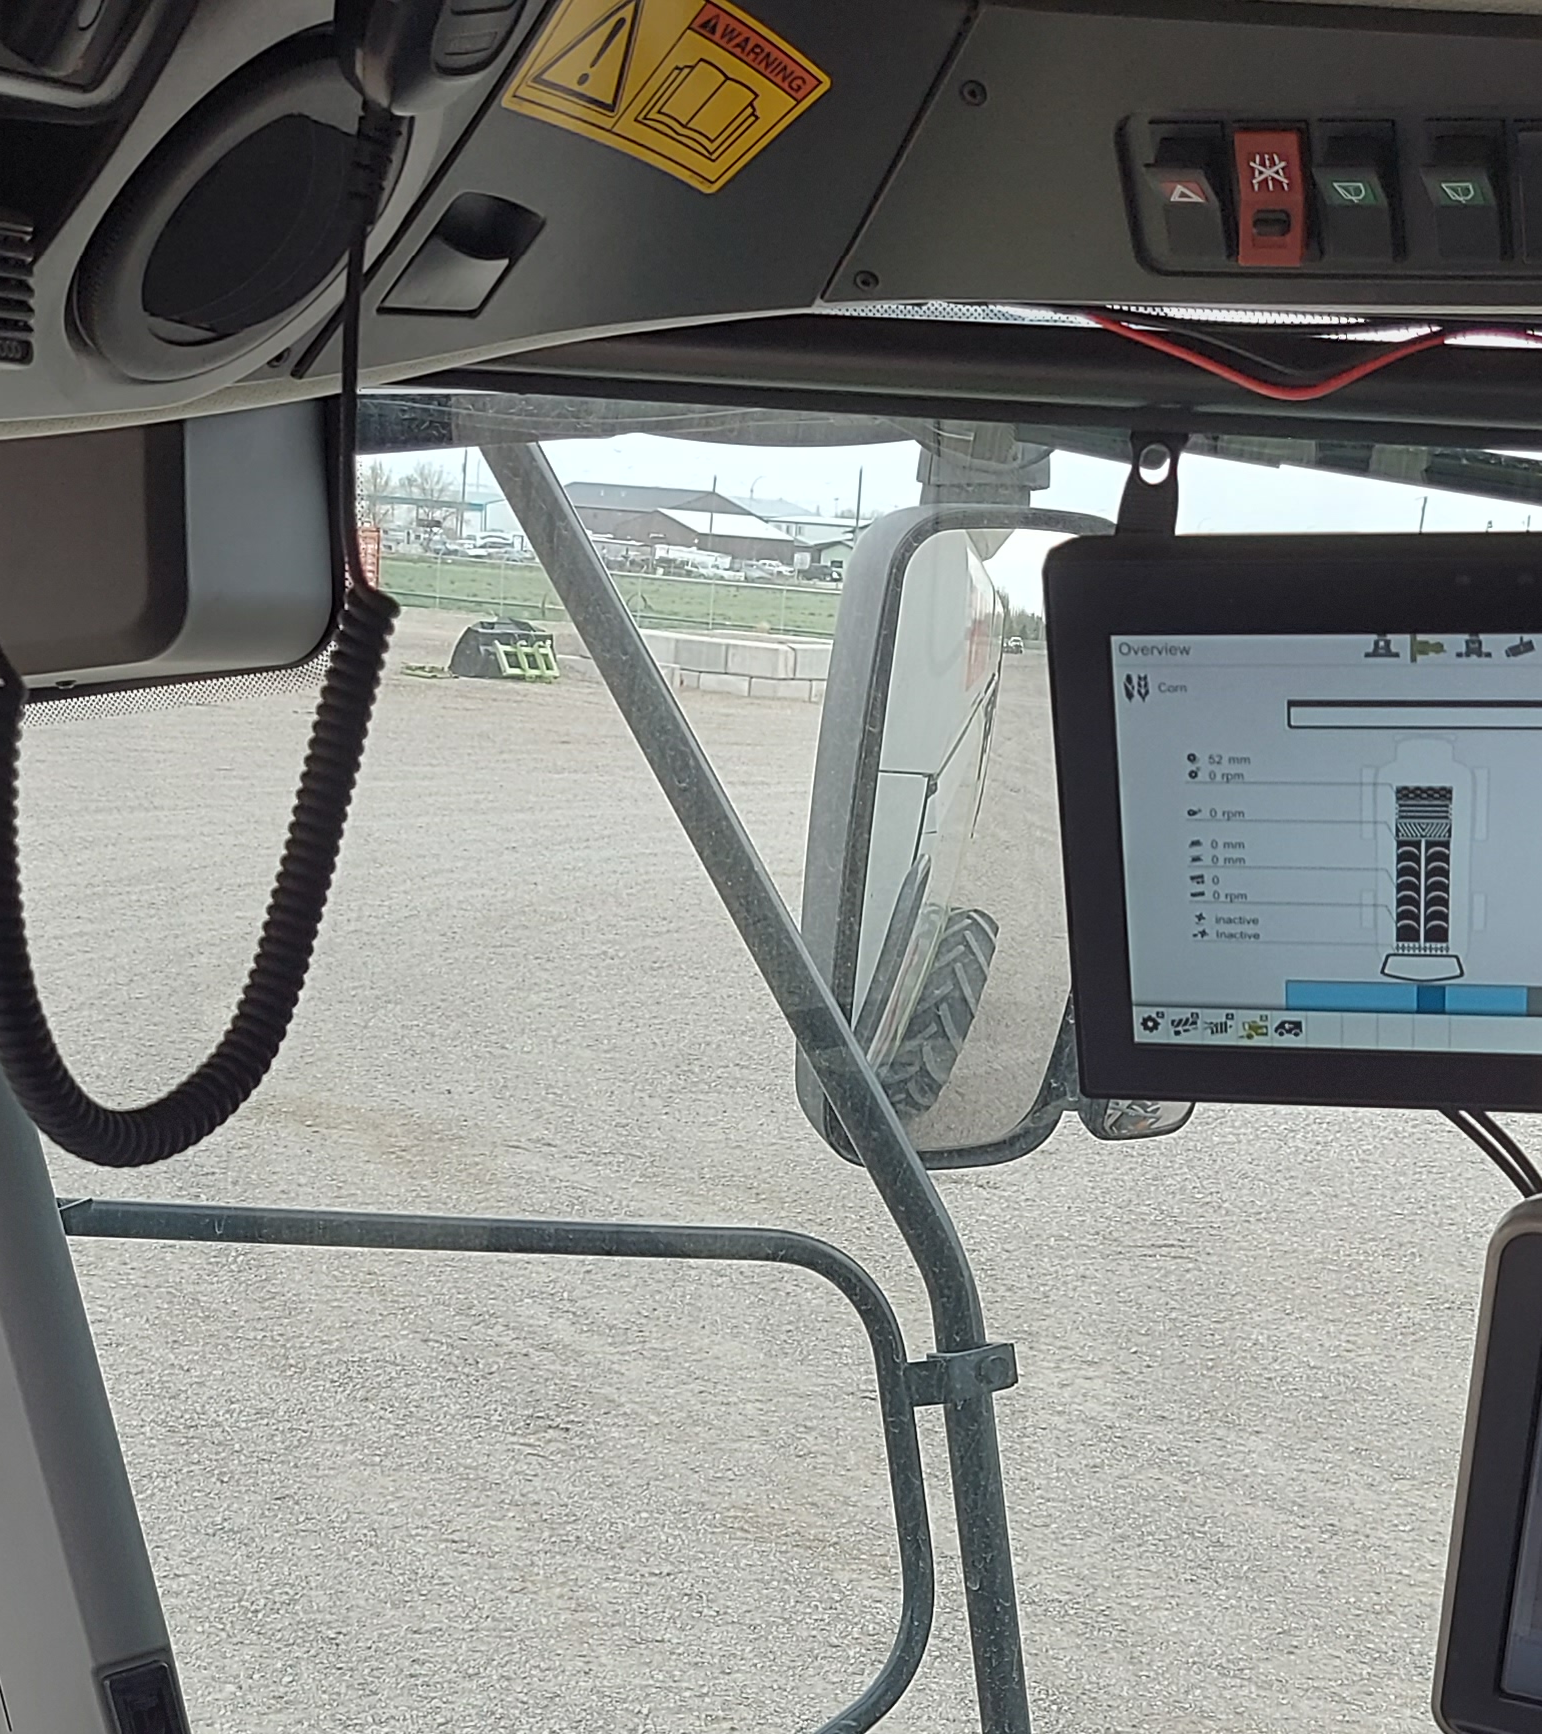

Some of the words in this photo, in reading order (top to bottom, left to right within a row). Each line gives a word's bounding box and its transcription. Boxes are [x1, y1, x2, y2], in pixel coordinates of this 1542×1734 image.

[720, 23, 807, 94] WARNING
[1118, 641, 1191, 657] Overview
[1158, 682, 1188, 694] Corn
[1208, 754, 1223, 765] 52
[1228, 756, 1251, 765] mm
[1208, 770, 1217, 780] 0
[1221, 772, 1245, 784] rpm
[1209, 808, 1217, 818] 0
[1222, 810, 1245, 821] rpm
[1210, 839, 1218, 850] 0
[1223, 841, 1245, 850] mm
[1211, 854, 1219, 865] 0
[1223, 857, 1246, 865] mm
[1212, 875, 1220, 885] 0
[1212, 890, 1221, 901] 0
[1225, 892, 1248, 903] rpm
